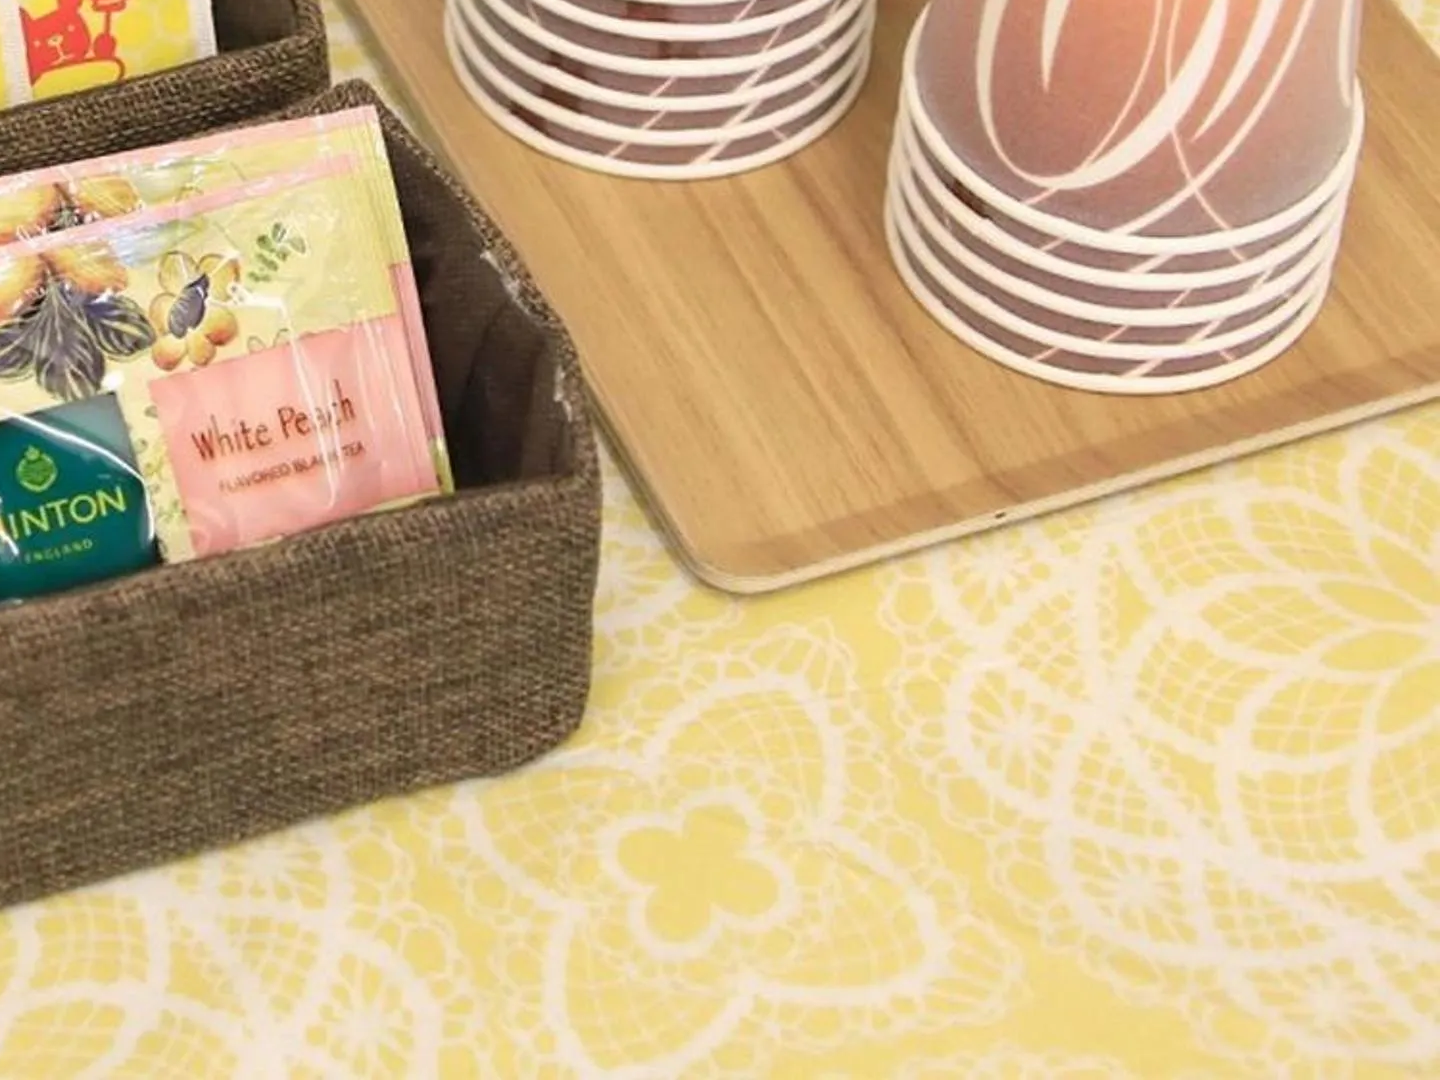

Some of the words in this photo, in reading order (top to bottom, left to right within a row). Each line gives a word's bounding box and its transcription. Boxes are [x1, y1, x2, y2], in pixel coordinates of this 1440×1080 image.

[191, 414, 273, 462] White
[277, 379, 356, 440] Peach
[341, 440, 366, 459] TEA
[24, 537, 93, 565] ENGLAND
